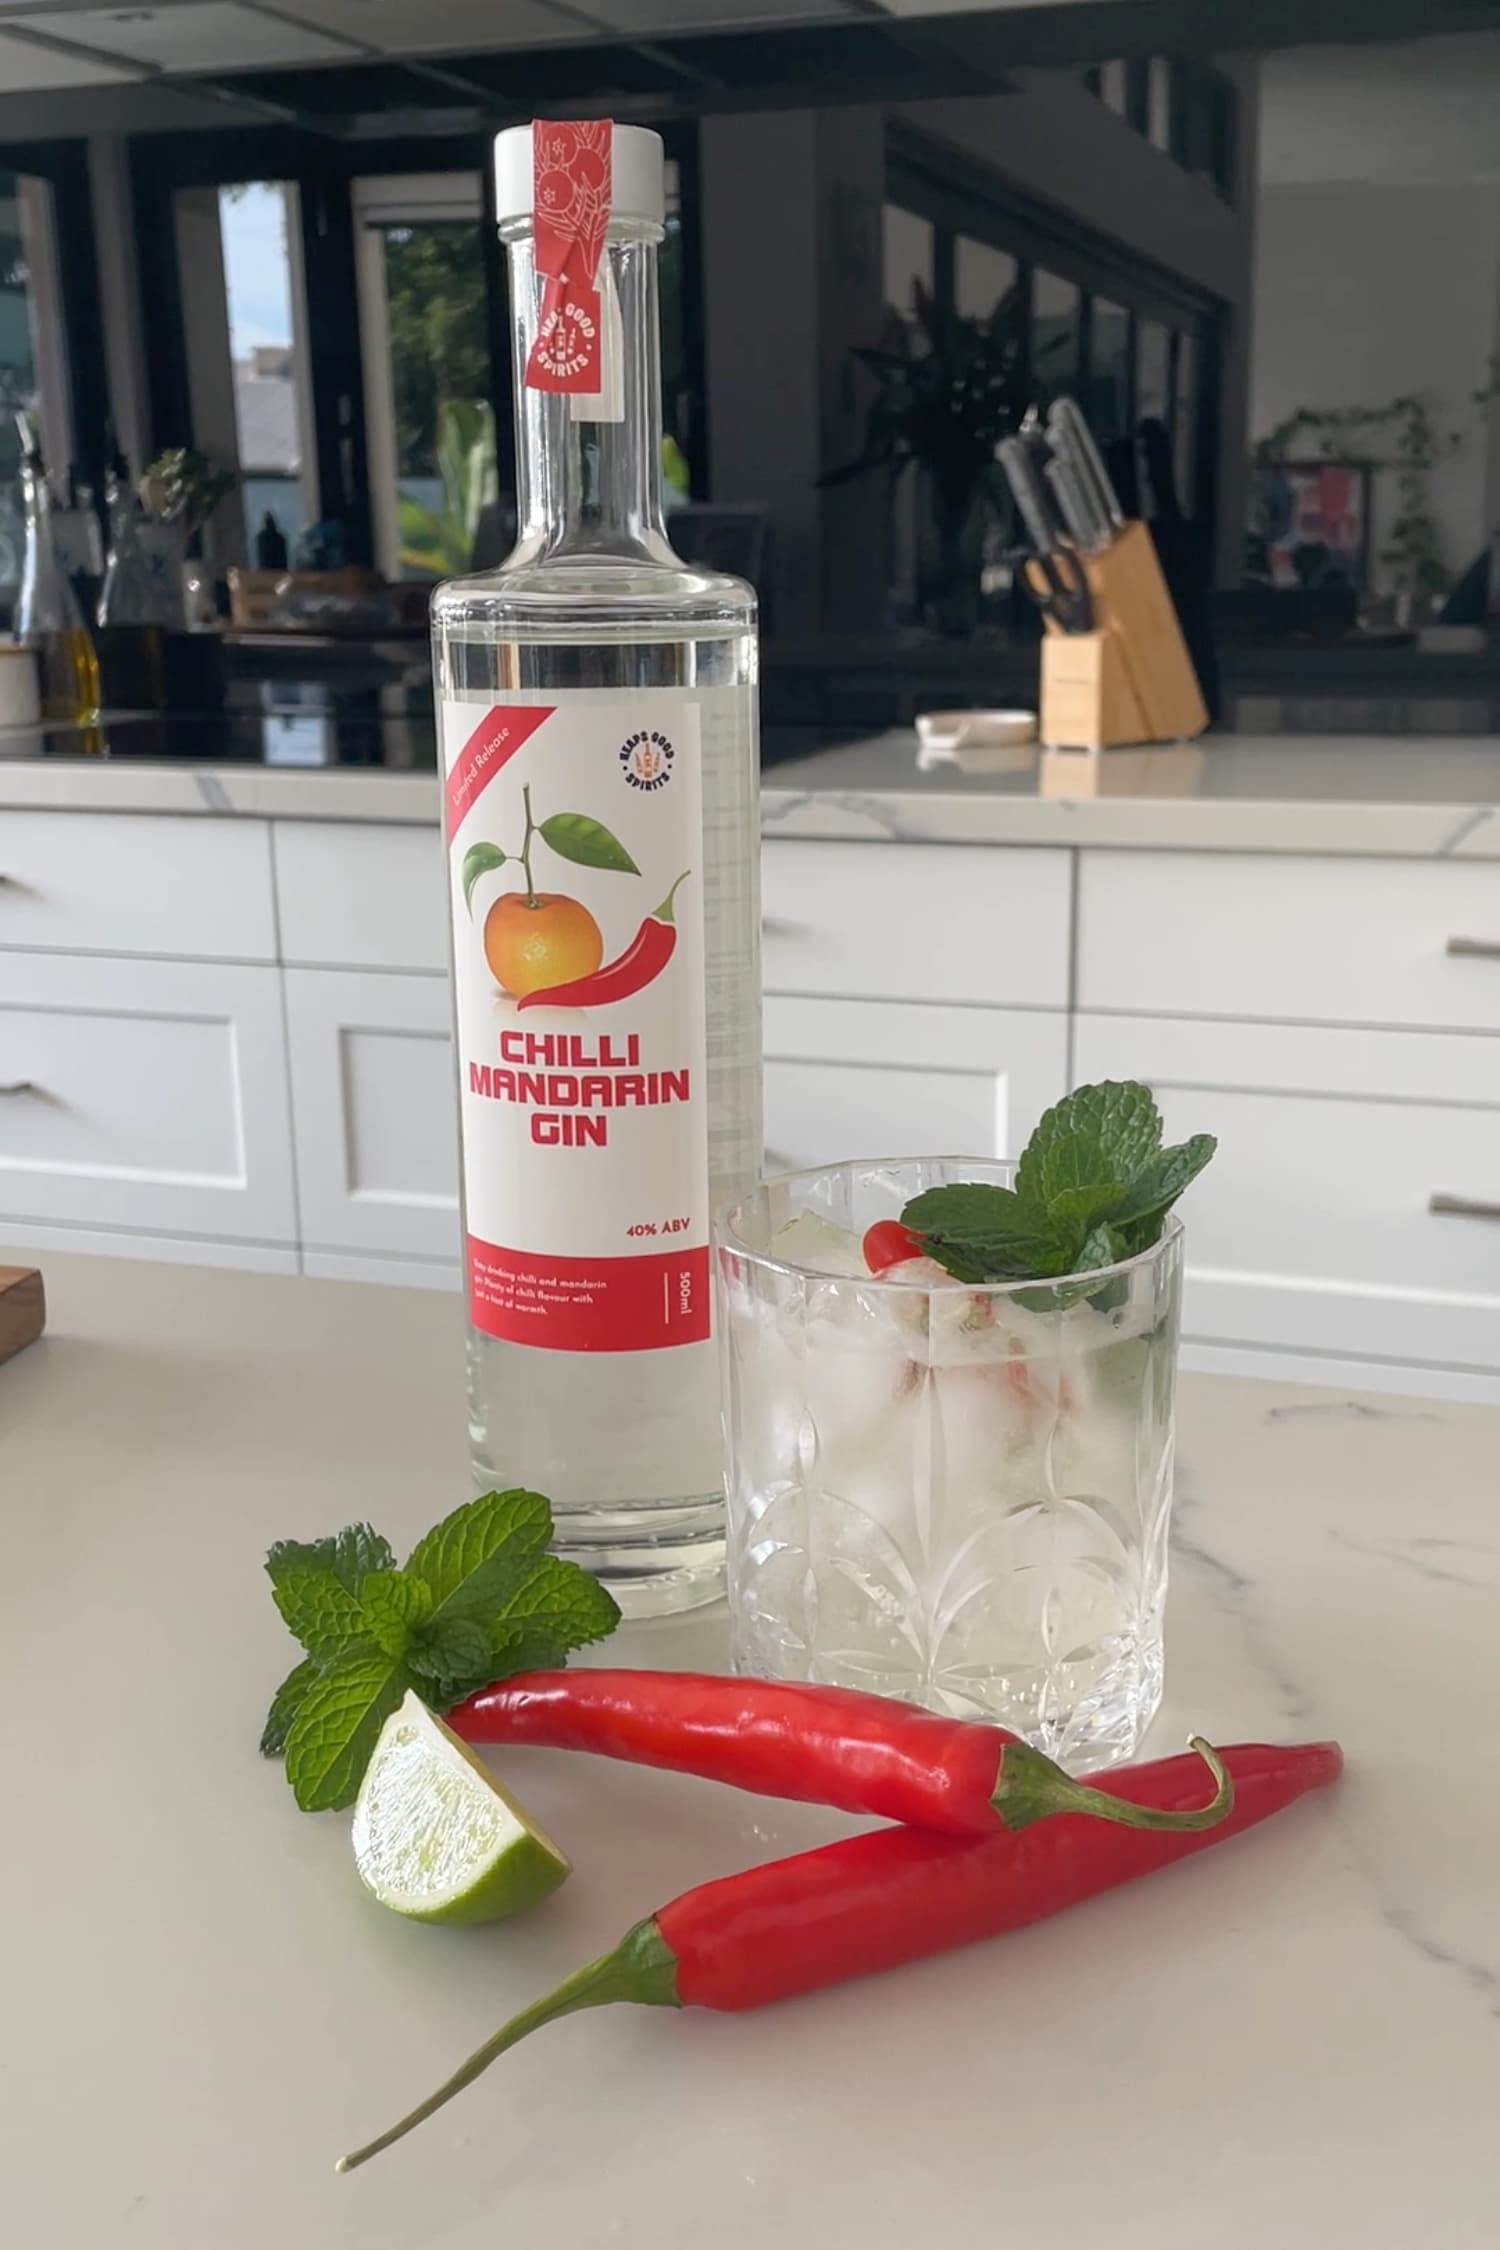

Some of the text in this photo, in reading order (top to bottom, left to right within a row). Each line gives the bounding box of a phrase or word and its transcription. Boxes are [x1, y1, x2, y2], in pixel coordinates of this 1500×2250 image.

[565, 303, 596, 338] GOOD
[537, 351, 589, 377] SPIRITS
[475, 727, 510, 768] Release
[619, 731, 675, 761] HEAPS GOOD
[625, 772, 670, 791] SPIRITS
[500, 1030, 639, 1067] CHILLI
[469, 1061, 690, 1108] MANDARIN
[530, 1112, 607, 1147] GIN
[627, 1217, 690, 1237] 40% ABV
[516, 1287, 535, 1299] chilli
[537, 1289, 570, 1303] flavour
[572, 1293, 593, 1304] with
[517, 1272, 536, 1284] chilli
[538, 1277, 557, 1287] and
[559, 1278, 607, 1289] mandarin
[680, 1271, 692, 1315] 500ml
